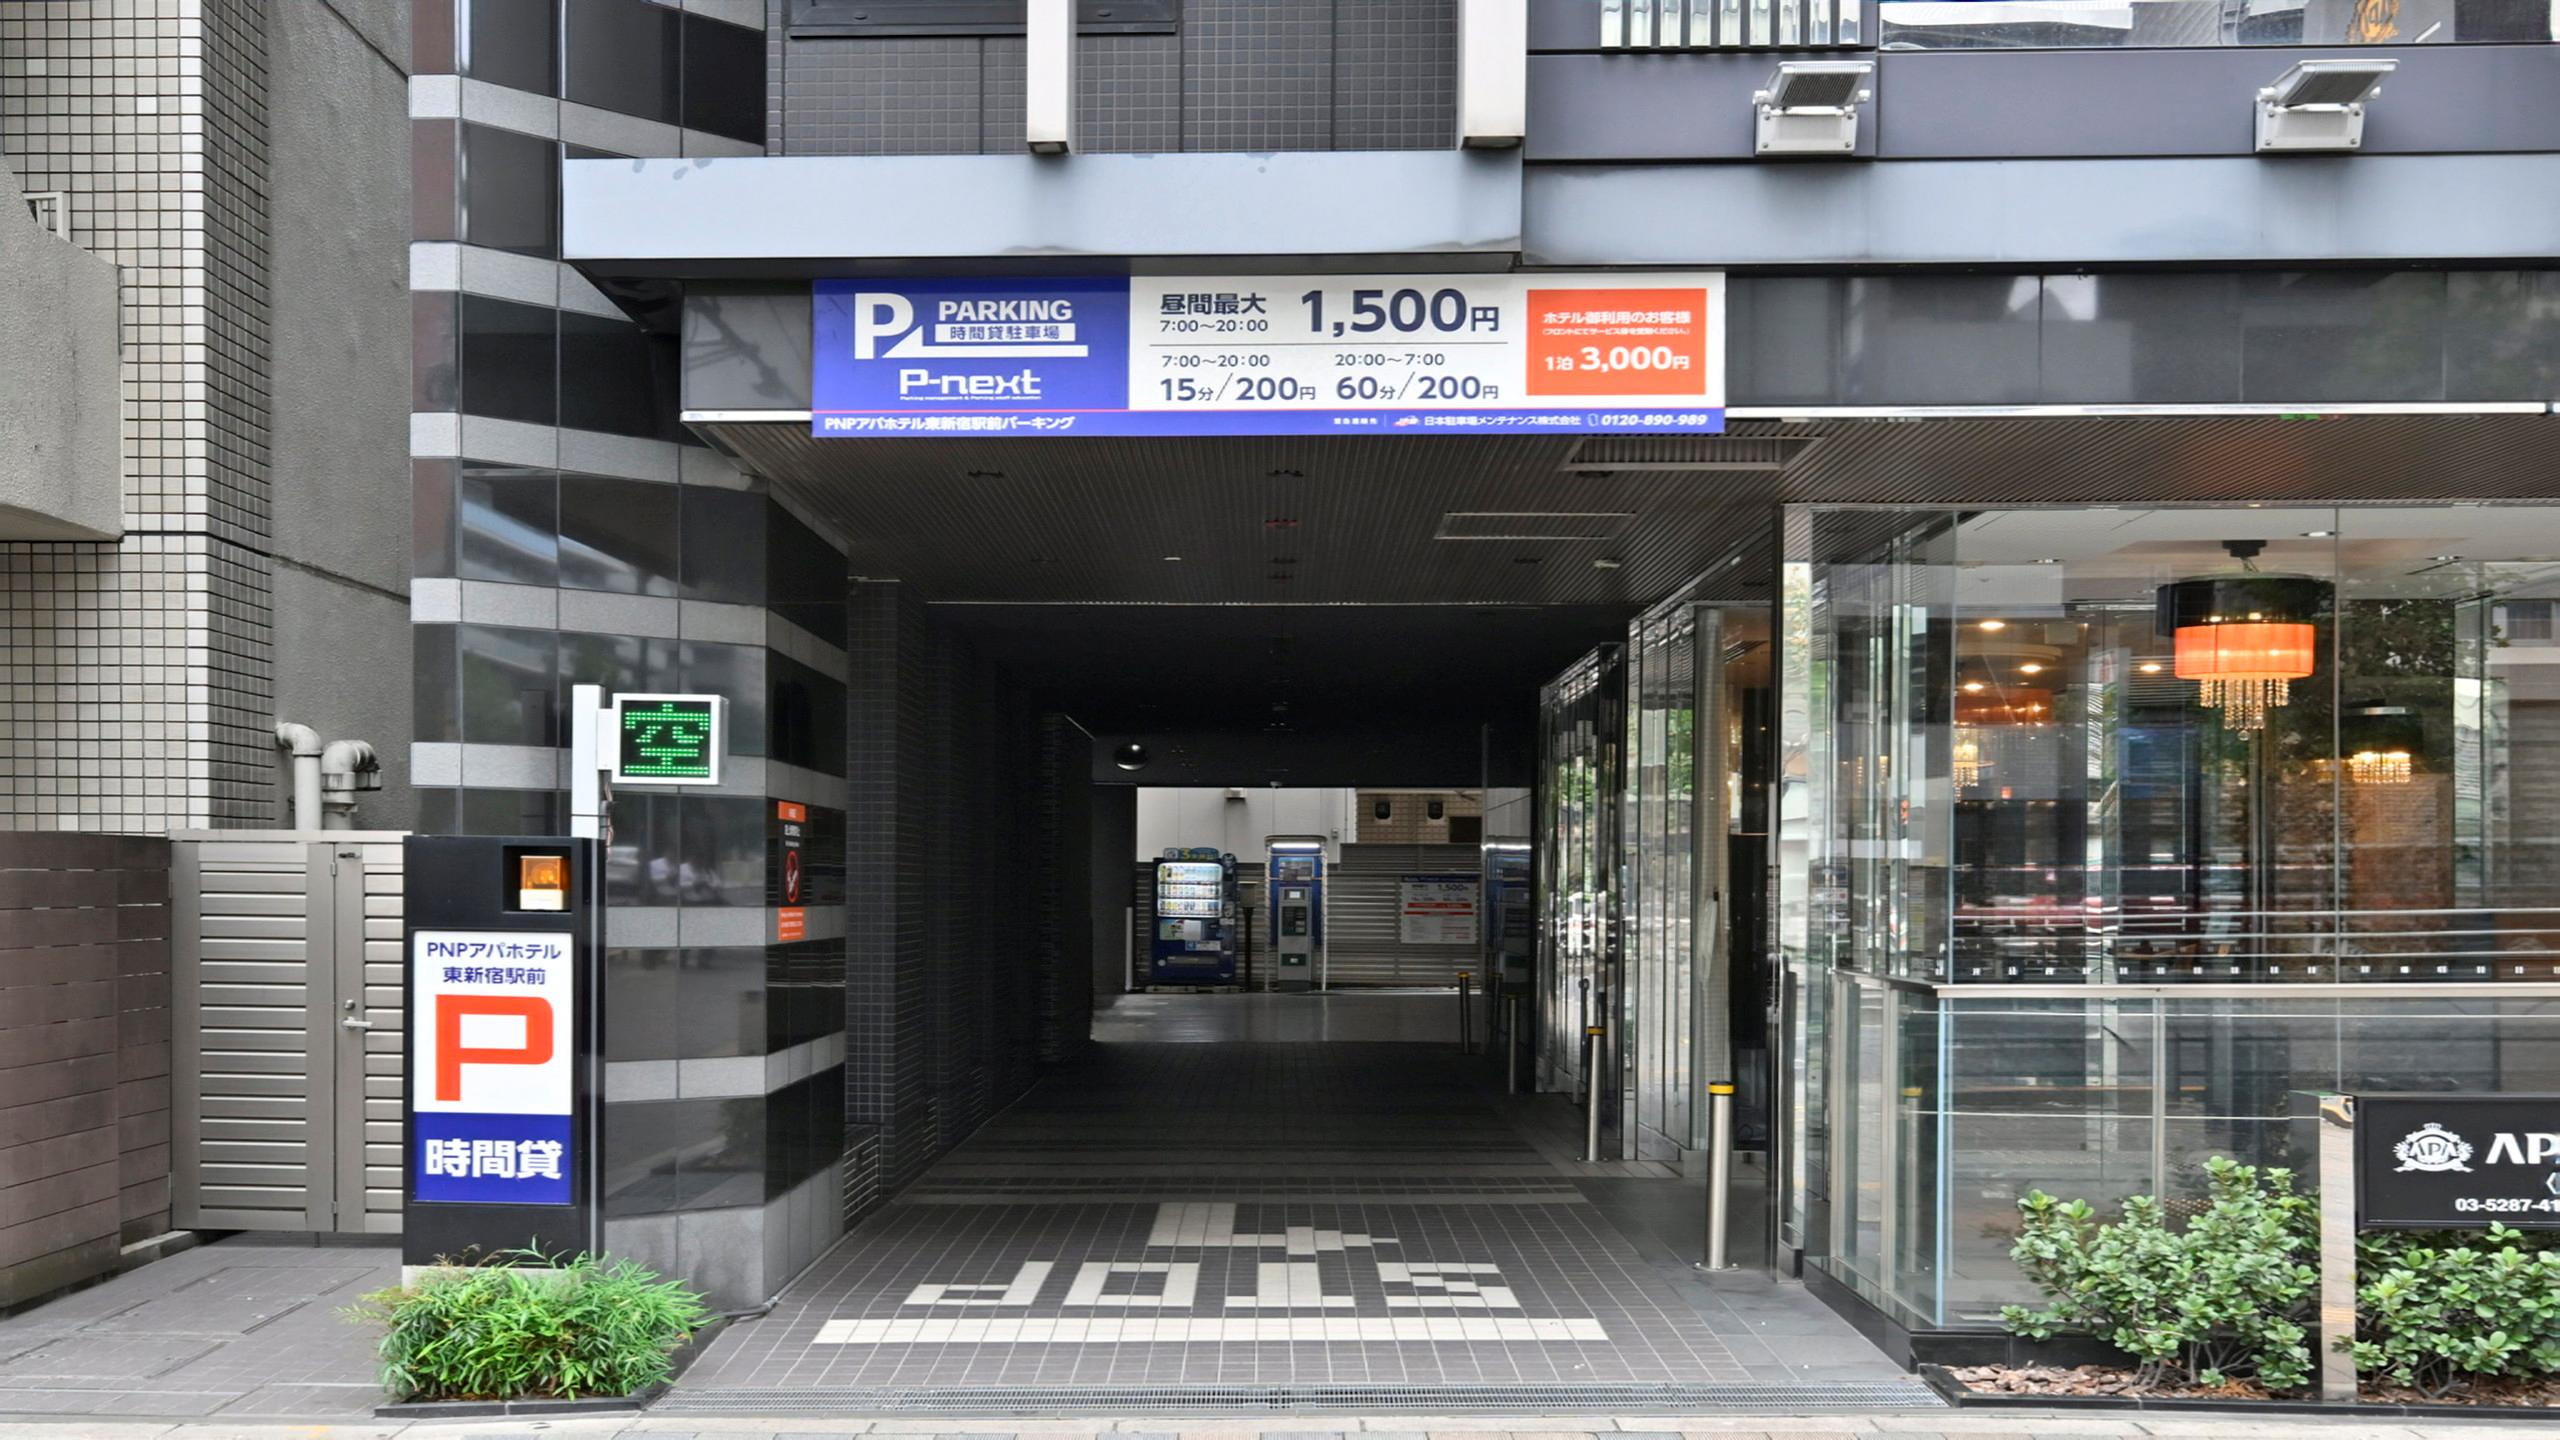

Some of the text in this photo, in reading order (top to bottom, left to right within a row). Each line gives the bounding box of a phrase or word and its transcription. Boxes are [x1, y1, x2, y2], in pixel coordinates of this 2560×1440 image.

[938, 300, 1073, 322] PARKING
[1160, 293, 1267, 315] 昼間最大
[1301, 288, 1500, 338] 1,500円
[949, 325, 1061, 341] 時間貸駐車場
[1545, 346, 1690, 373] 1泊 3,000円
[900, 369, 1041, 395] P-next
[1601, 414, 1708, 427] 0120-890-989
[623, 703, 711, 776] 空
[426, 941, 562, 961] PNPアパホテル
[442, 966, 546, 985] 東新宿駅前
[435, 994, 554, 1102] P
[425, 1138, 562, 1180] 時間貸
[2485, 1132, 2560, 1165] AP
